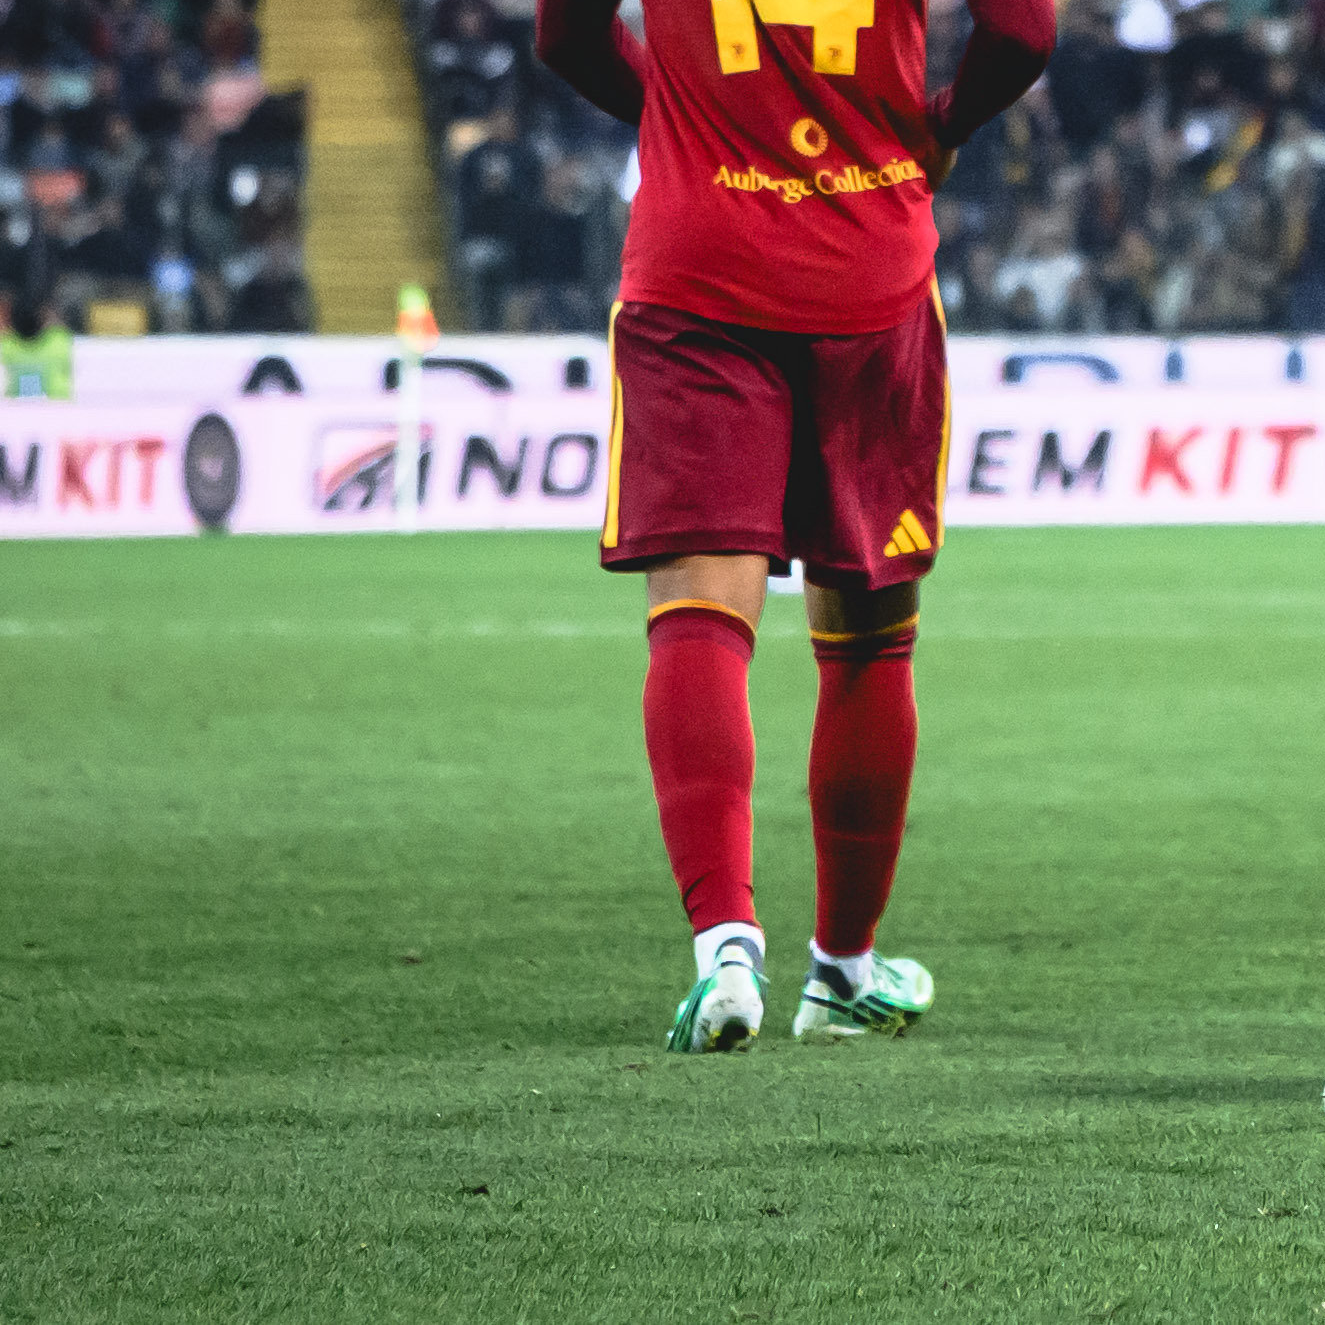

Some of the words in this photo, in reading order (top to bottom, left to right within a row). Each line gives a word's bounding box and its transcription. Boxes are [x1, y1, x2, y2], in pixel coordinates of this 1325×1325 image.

[57, 437, 165, 509] KIT
[455, 432, 599, 499] NO
[1138, 426, 1318, 496] KIT
